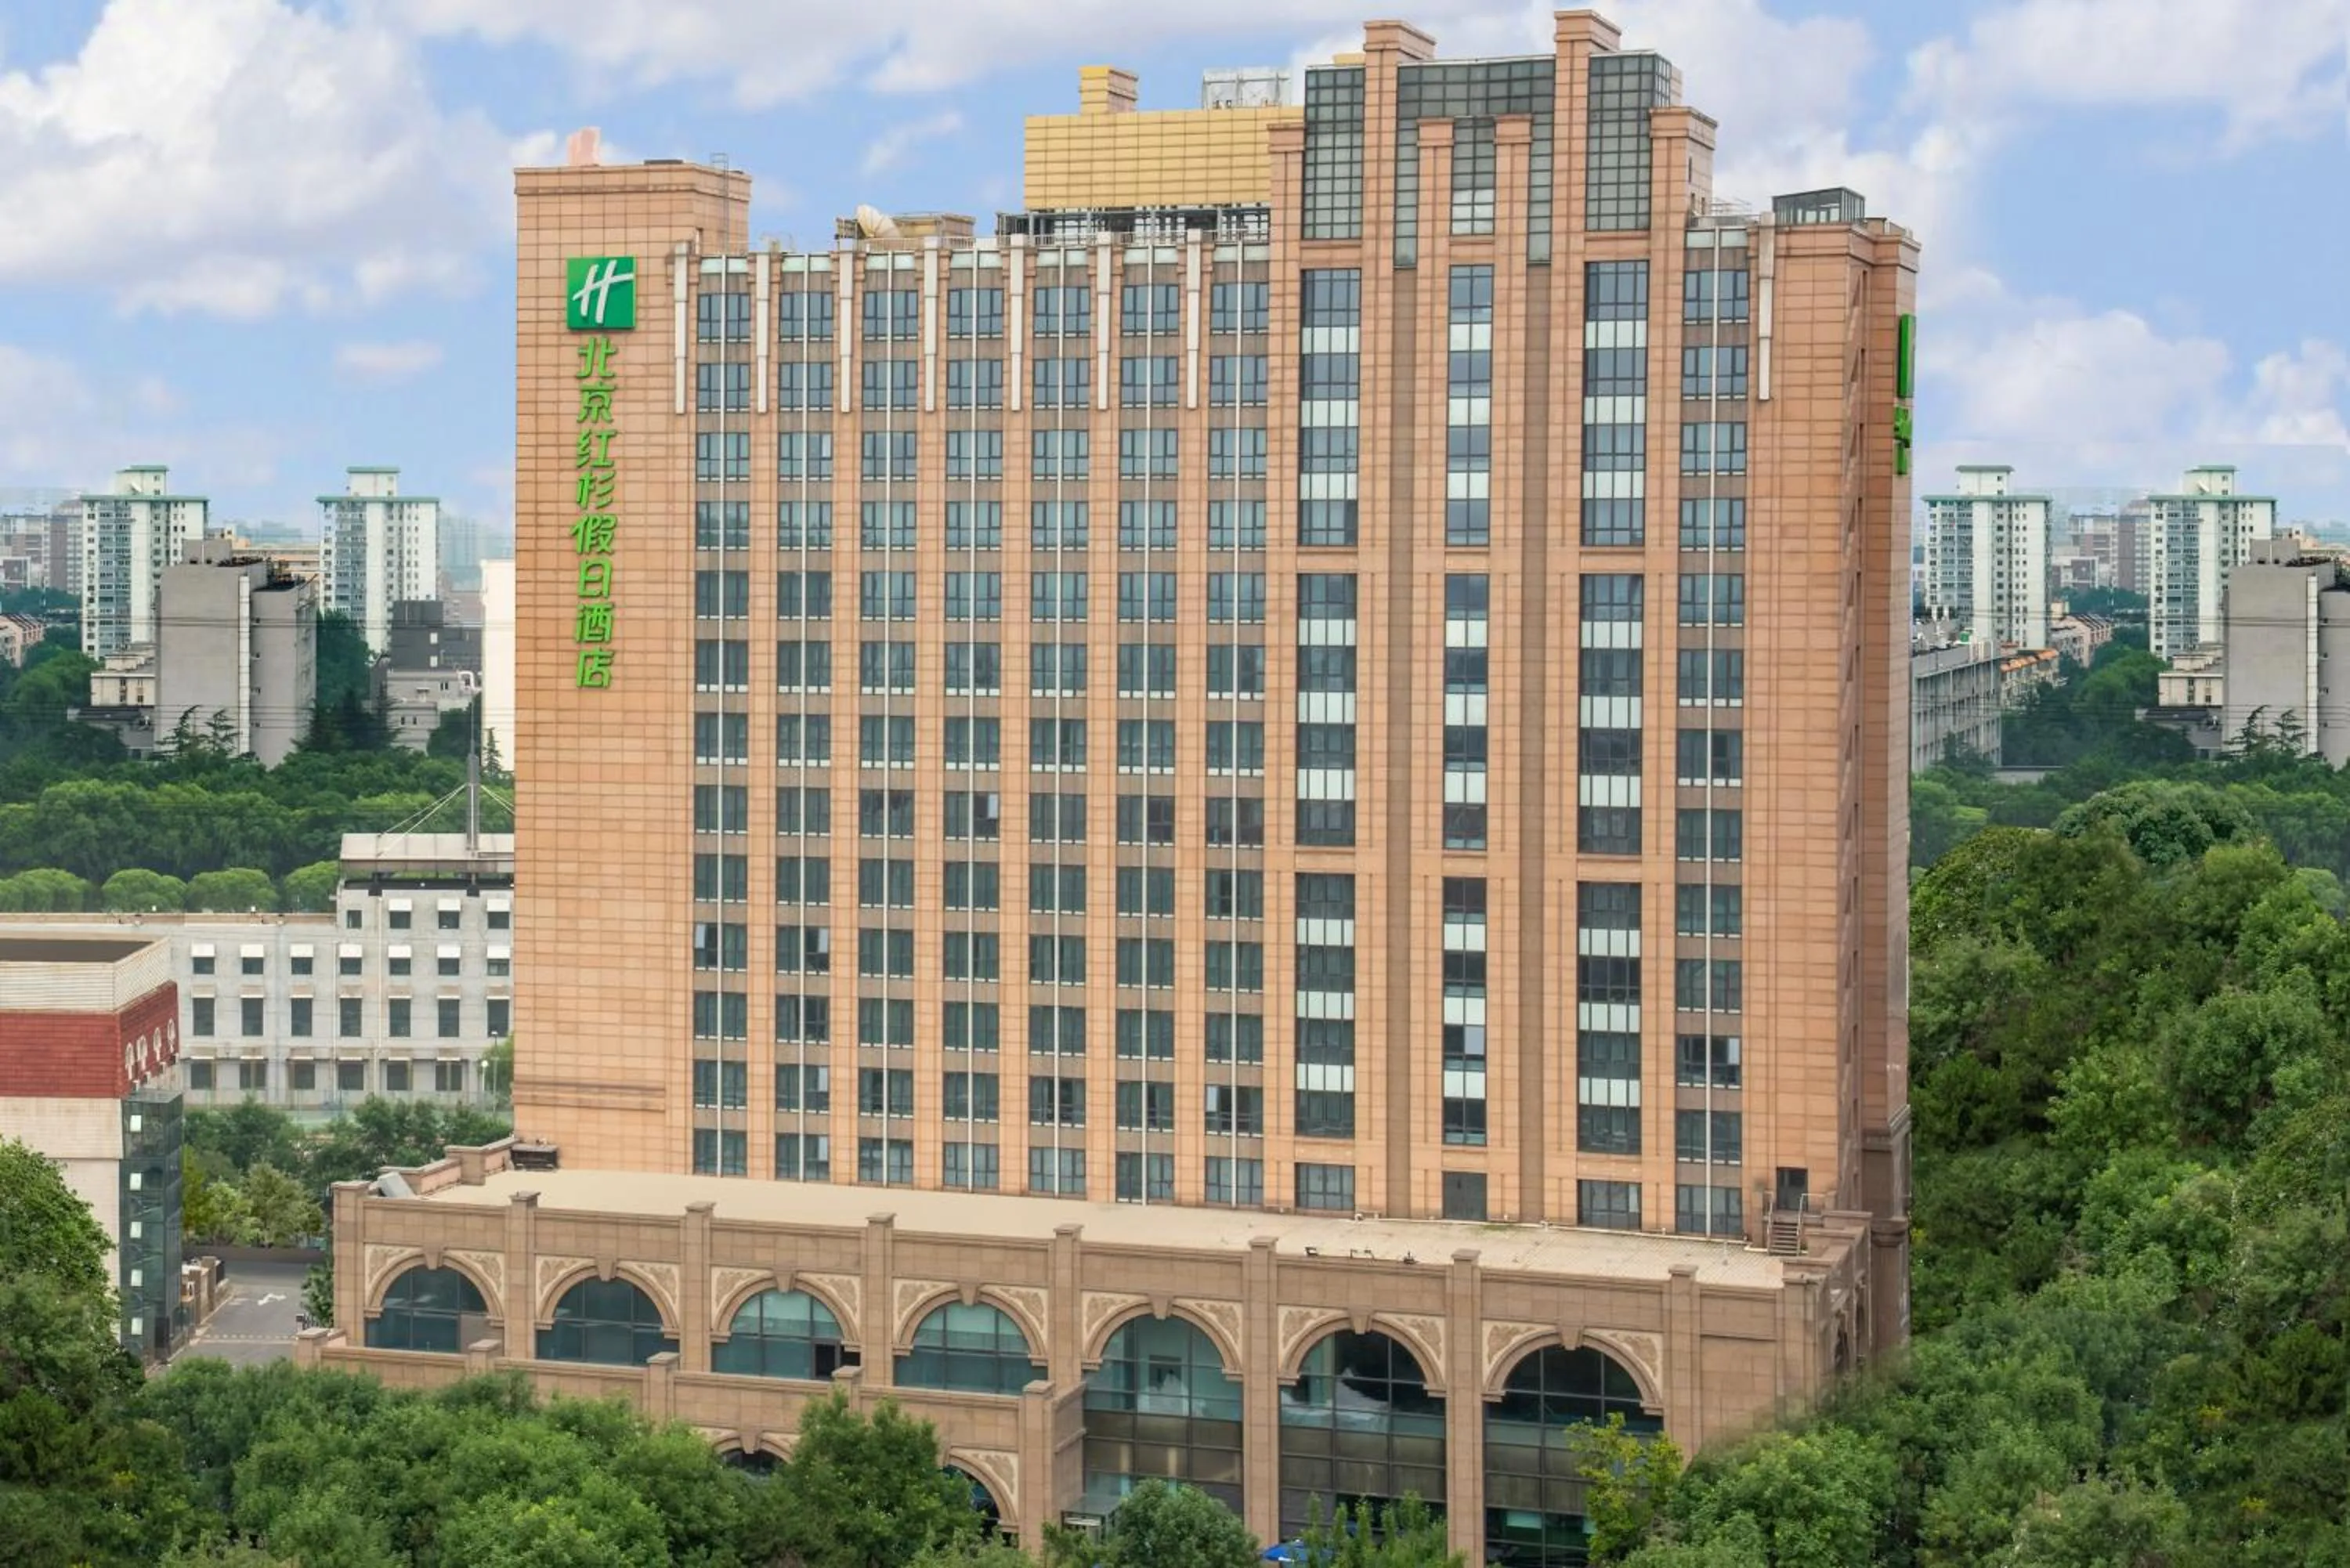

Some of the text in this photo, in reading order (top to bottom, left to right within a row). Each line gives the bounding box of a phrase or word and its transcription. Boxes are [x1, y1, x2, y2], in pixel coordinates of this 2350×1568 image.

[570, 337, 617, 688] 北京红杉假日酒店
